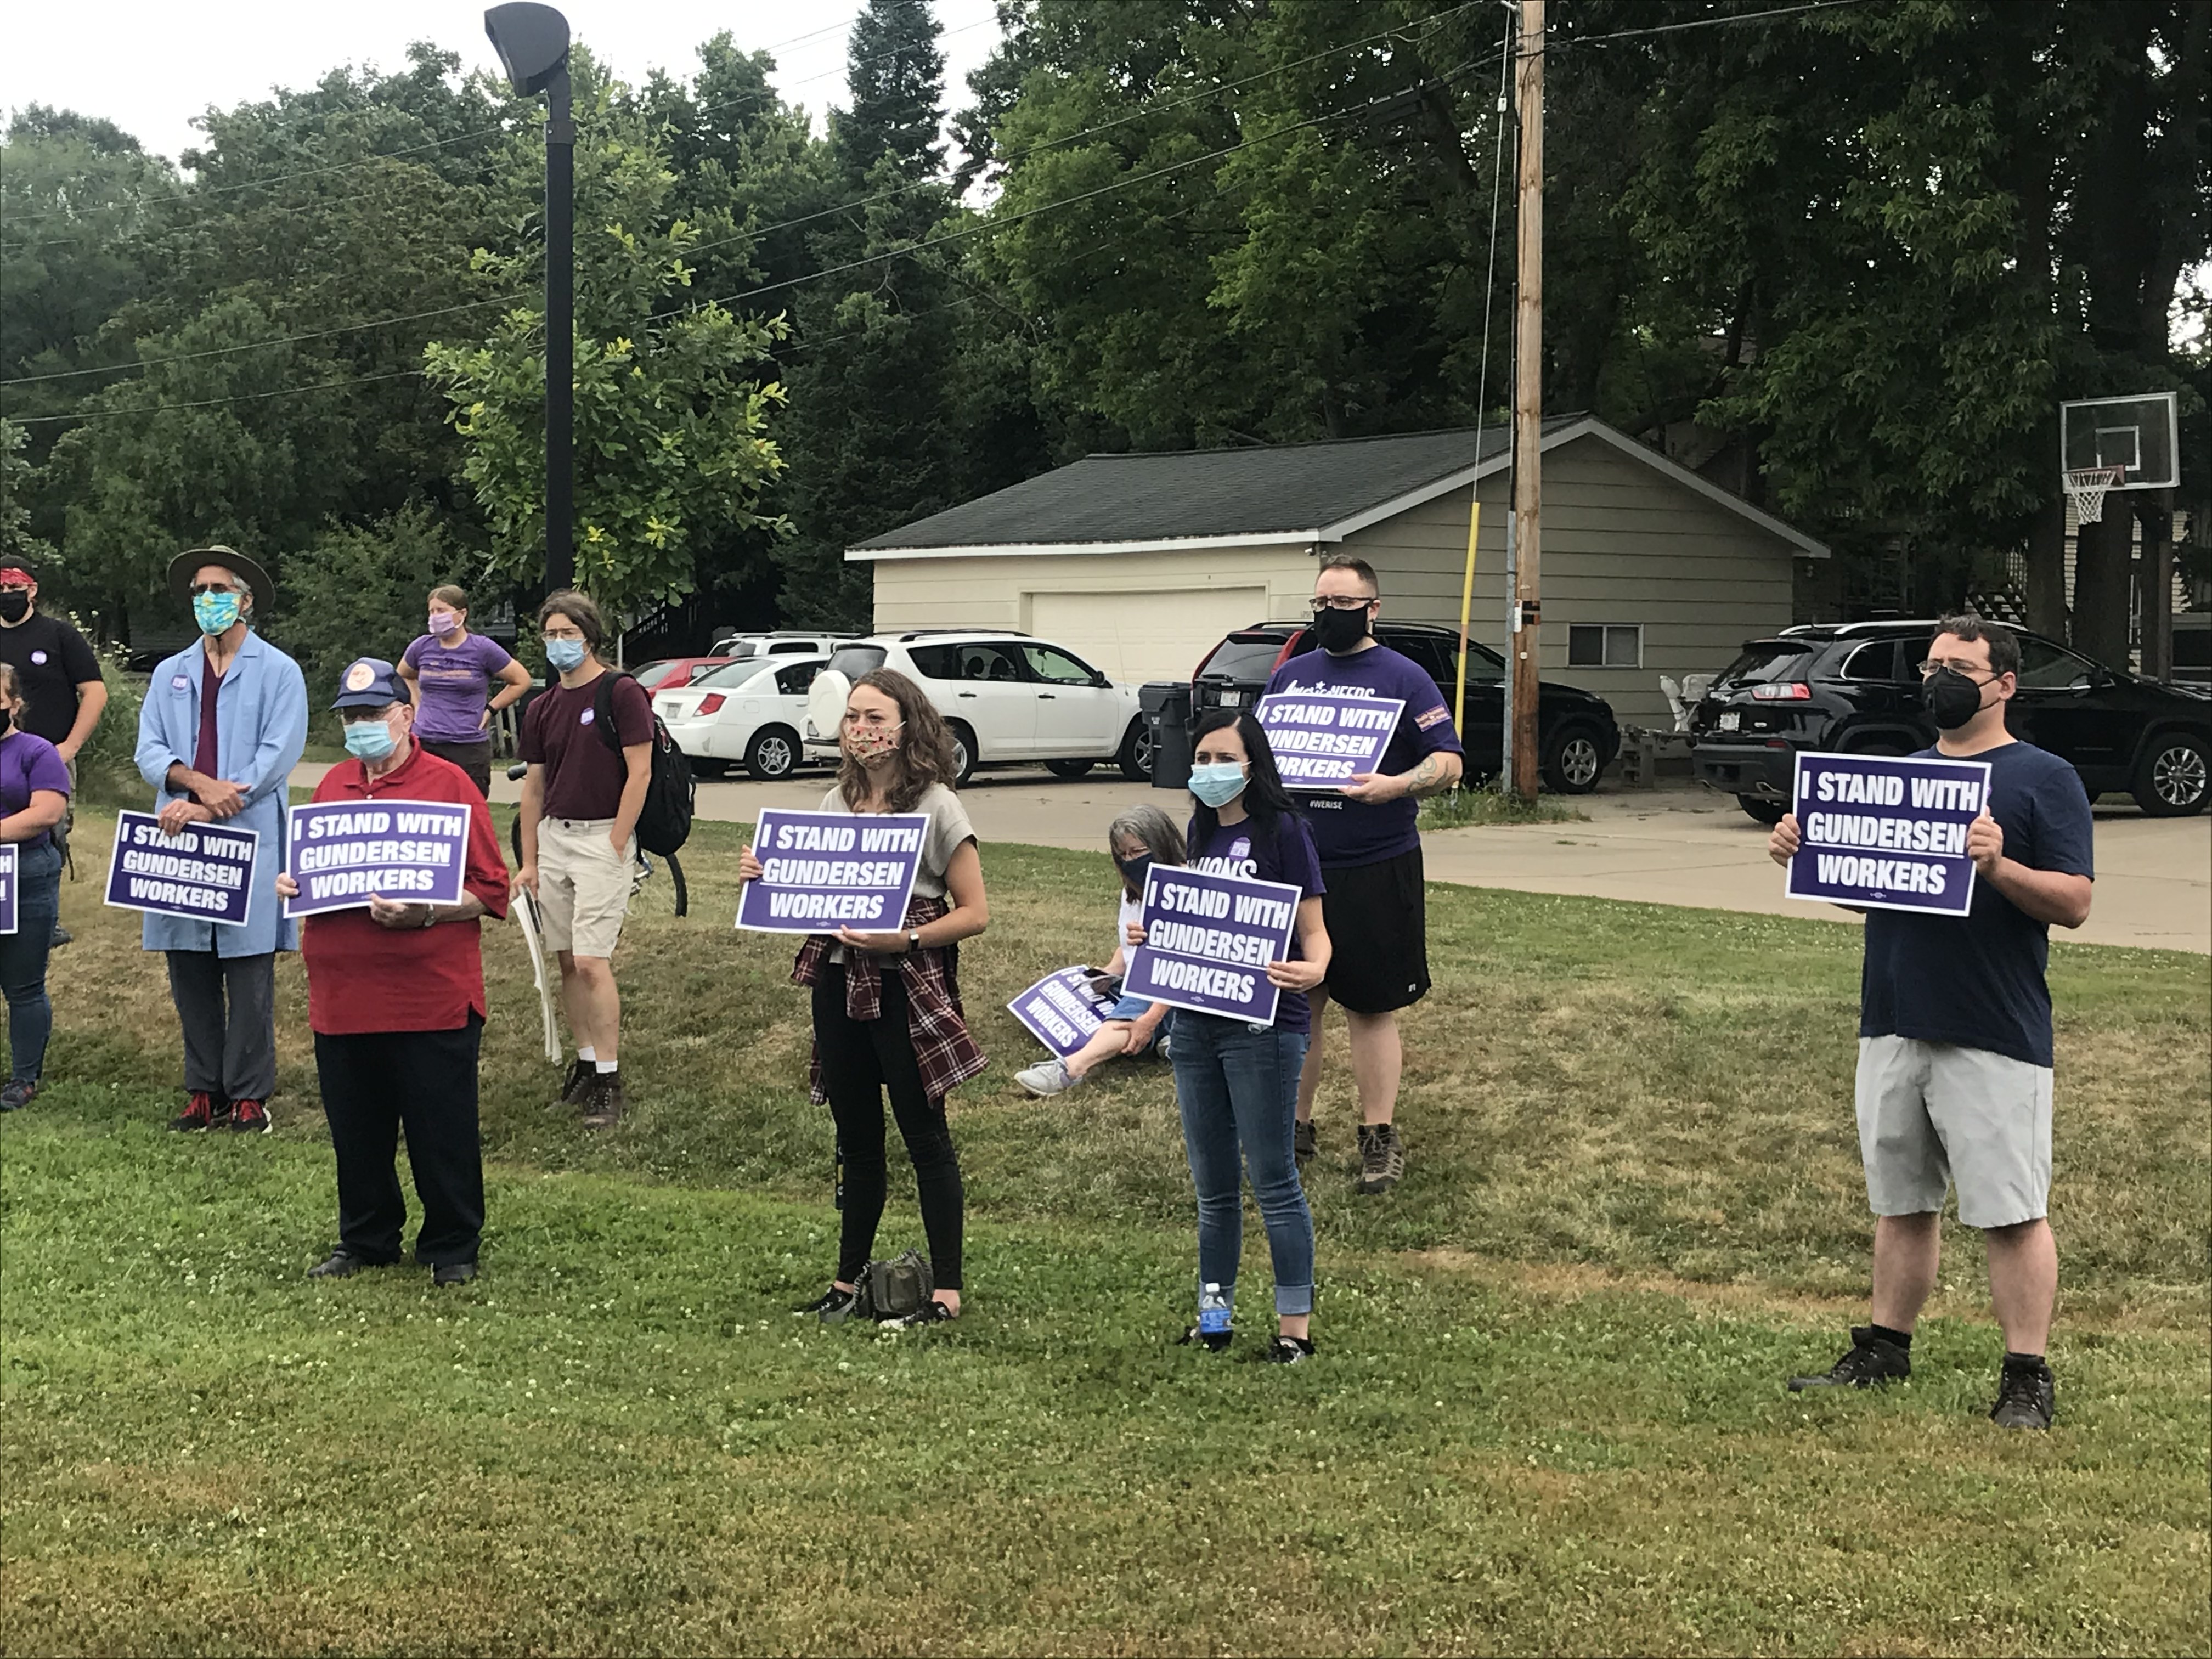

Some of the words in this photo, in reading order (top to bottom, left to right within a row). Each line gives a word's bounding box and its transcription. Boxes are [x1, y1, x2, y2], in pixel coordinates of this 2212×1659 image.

[1259, 706, 1269, 724] I
[1268, 704, 1337, 726] STAND
[1339, 707, 1394, 731] WITH
[1265, 730, 1378, 755] UNDERSEN
[1273, 755, 1355, 778] ORKERS
[1801, 771, 1810, 799] I
[1817, 772, 1904, 805] STAND
[1911, 778, 1980, 811] WITH
[121, 823, 130, 842] I
[133, 825, 199, 853] STAND
[204, 836, 252, 861] WITH
[294, 819, 302, 840] I
[308, 812, 390, 839] STAND
[397, 812, 462, 837] WITH
[760, 824, 771, 847] I
[776, 825, 856, 851] STAND
[861, 828, 919, 852] WITH
[1807, 812, 1967, 854] GUNDERSEN
[123, 850, 242, 887] GUNDERSEN
[300, 840, 451, 870] GUNDERSEN
[762, 858, 905, 885] GUNDERSEN
[311, 869, 434, 899] WORKERS
[1818, 854, 1947, 895] WORKERS
[130, 878, 228, 911] WORKERS
[770, 892, 884, 919] WORKERS
[1148, 881, 1158, 907] I
[1160, 883, 1231, 919] STAND
[1234, 895, 1291, 930] WITH
[1149, 919, 1276, 967] GUNDERSEN
[1150, 958, 1255, 1003] WORKERS
[1025, 996, 1078, 1047] WORKERS
[1042, 980, 1103, 1034] GUNDERSEN
